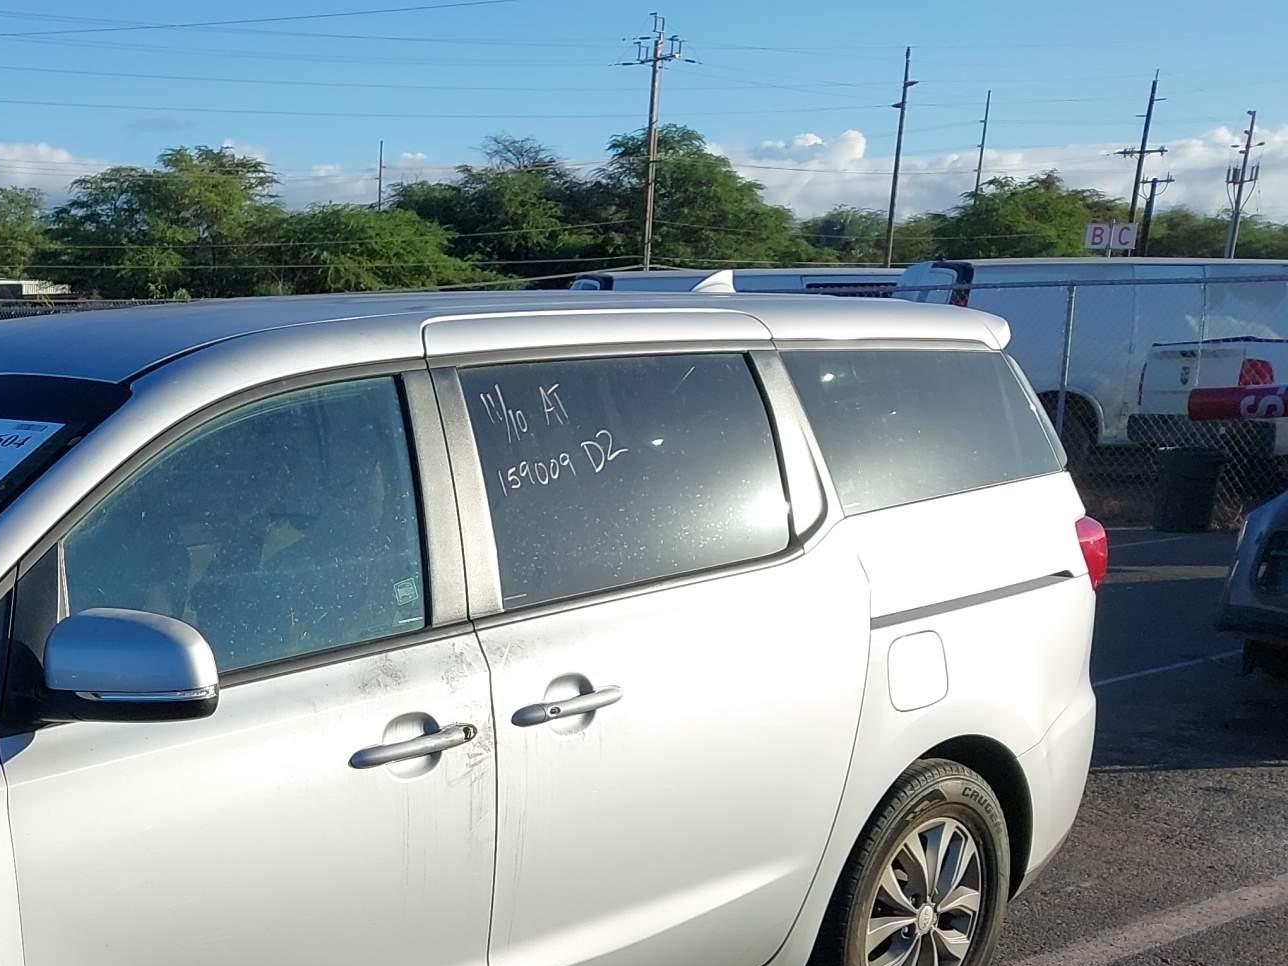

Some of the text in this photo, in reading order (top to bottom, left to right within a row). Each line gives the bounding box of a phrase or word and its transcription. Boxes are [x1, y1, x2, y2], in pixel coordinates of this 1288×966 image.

[1091, 226, 1105, 246] B
[1118, 226, 1131, 246] C
[479, 383, 569, 444] 11/10 AT
[497, 429, 630, 497] 159009 D2
